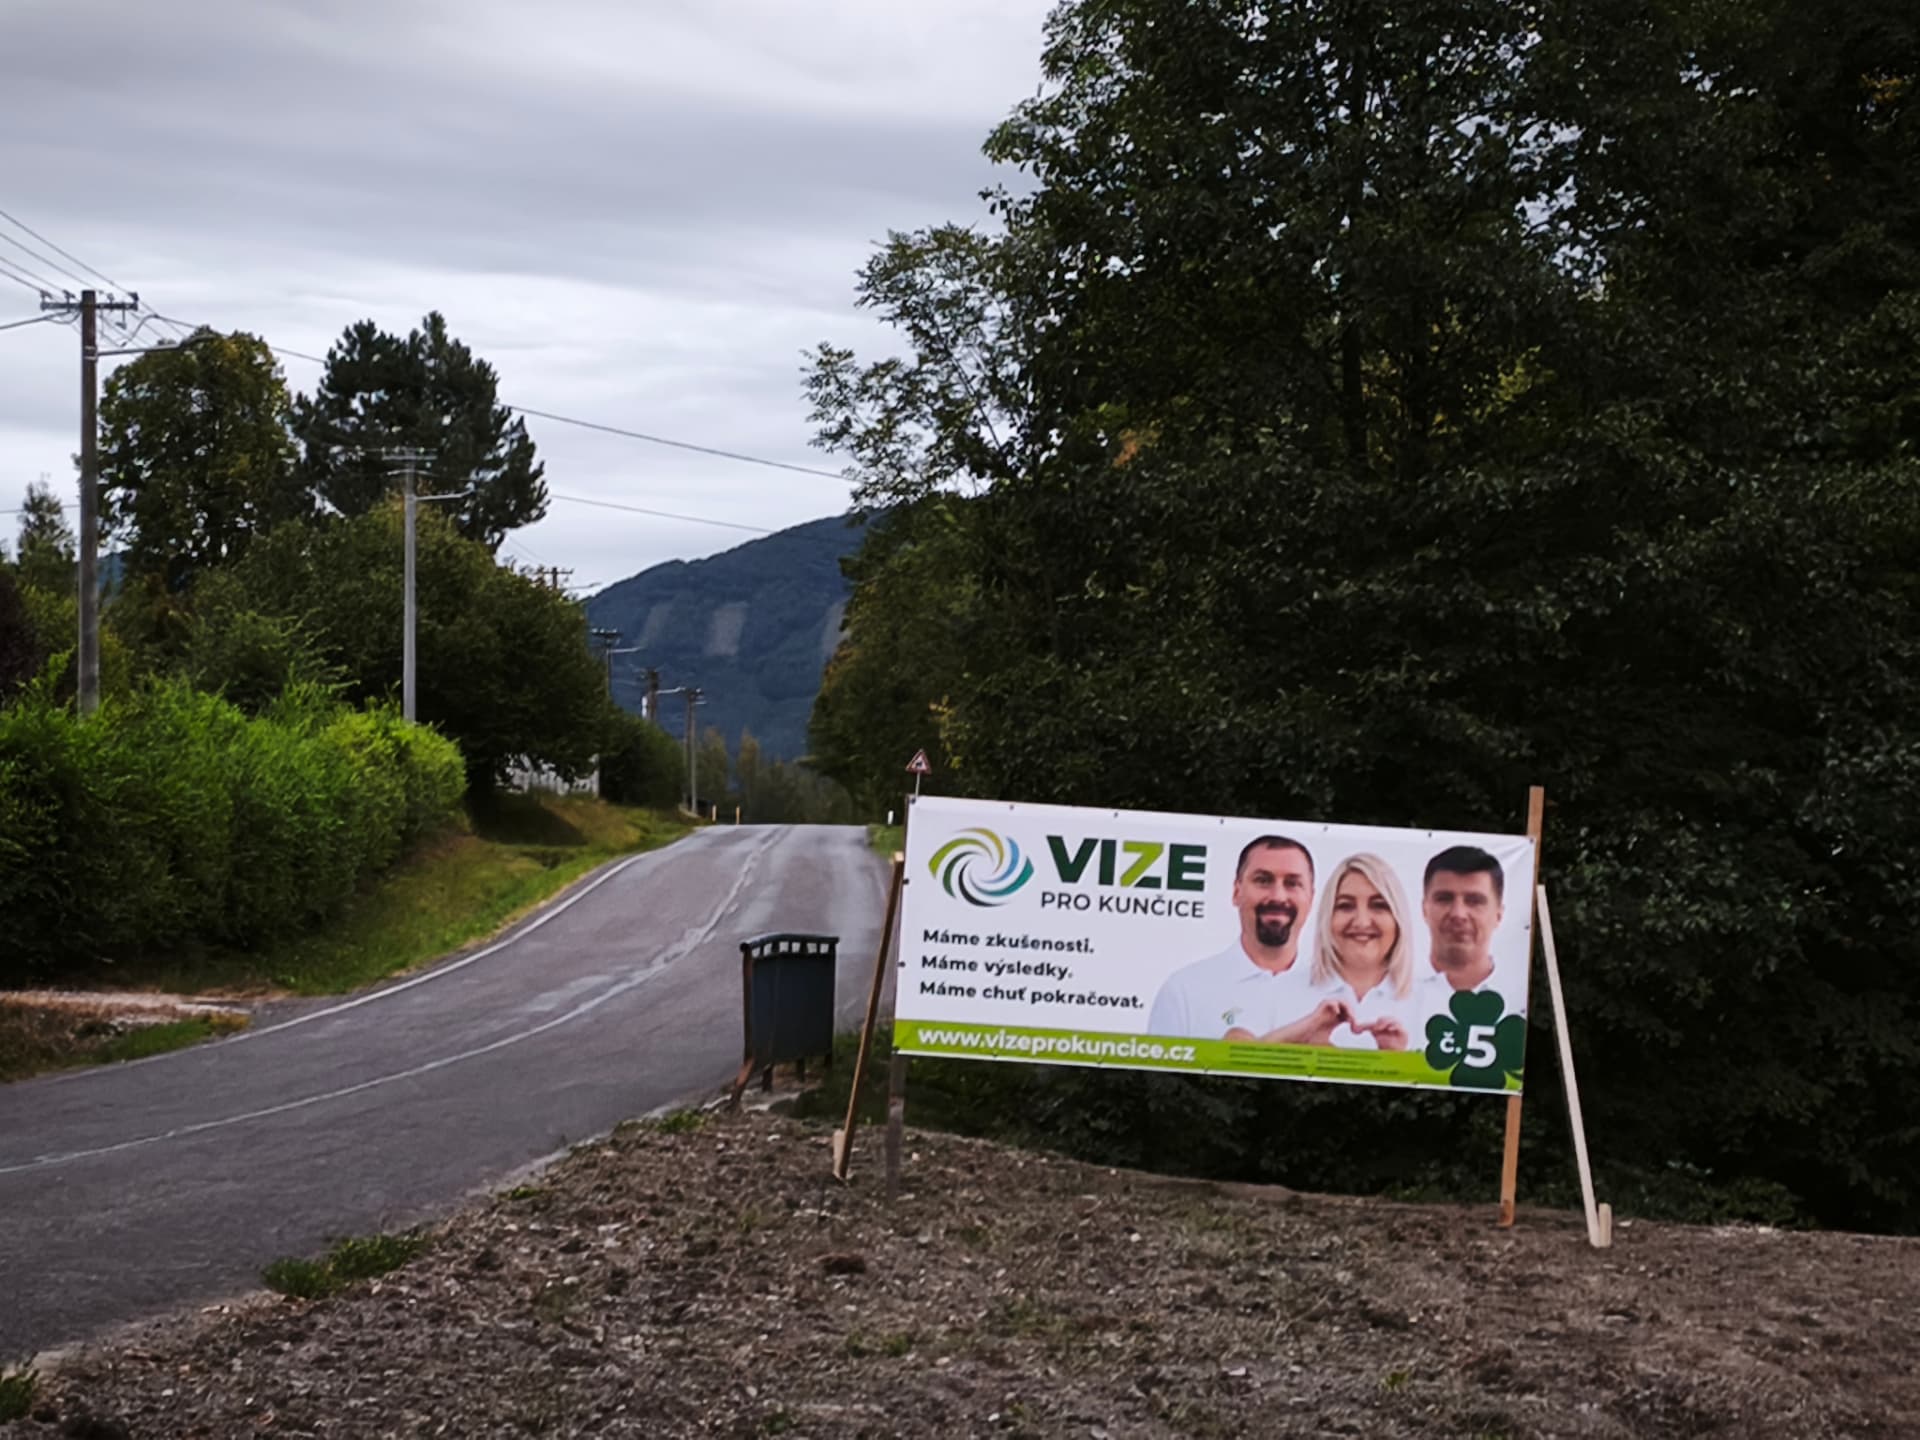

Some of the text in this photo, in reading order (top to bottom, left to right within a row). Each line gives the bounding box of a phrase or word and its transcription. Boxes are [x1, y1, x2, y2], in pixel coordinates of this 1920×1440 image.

[1046, 835, 1207, 892] VIZE
[1041, 892, 1205, 918] PRO KUNČICE
[923, 930, 1095, 953] Máme zkušenosti.
[921, 956, 1073, 979] Máme výsledky.
[920, 982, 1144, 1009] Máme chuť pokračovat.
[917, 1028, 1195, 1062] www.vizeprokuncice.cz
